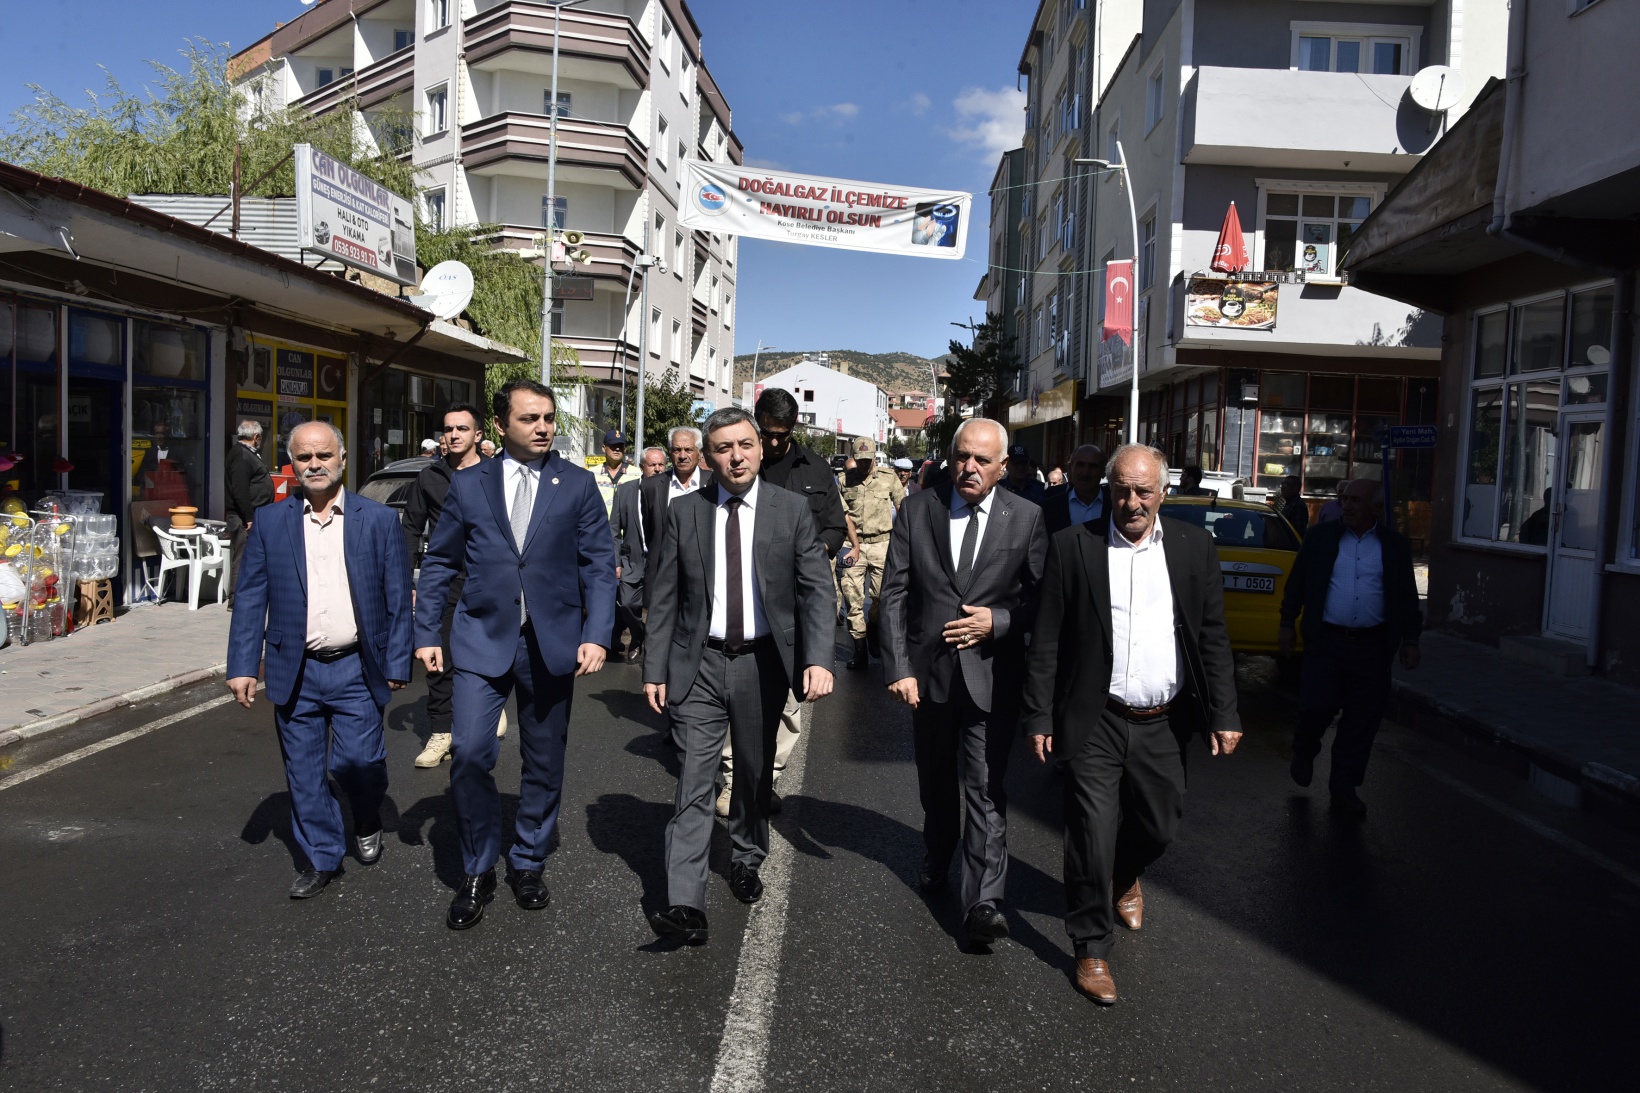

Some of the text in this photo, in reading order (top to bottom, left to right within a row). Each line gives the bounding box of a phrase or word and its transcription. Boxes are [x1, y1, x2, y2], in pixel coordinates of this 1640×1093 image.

[312, 150, 389, 211] CAN OLGUNLAR
[313, 178, 330, 198] GÜNEŞ
[331, 188, 352, 206] ENERJİSİ
[356, 200, 364, 212] KAT
[738, 177, 829, 202] DOĞALGAZ
[831, 186, 909, 210] İLÇEMİZE
[338, 208, 368, 231] HALI & OTO
[759, 201, 822, 222] HAYIRLI
[826, 210, 882, 228] OLSUN
[342, 224, 365, 243] YIKAMA
[787, 230, 838, 241] Turgay KESLER
[796, 222, 825, 232] Belediye
[827, 226, 855, 235] Başkanı
[350, 246, 360, 260] 923
[361, 251, 368, 263] 91
[369, 253, 376, 266] 72
[288, 353, 301, 364] CAN
[277, 366, 312, 379] OLGUNLAR
[243, 403, 271, 413] OLGUNLAR
[1233, 576, 1239, 587] T
[1246, 578, 1272, 589] 0502
